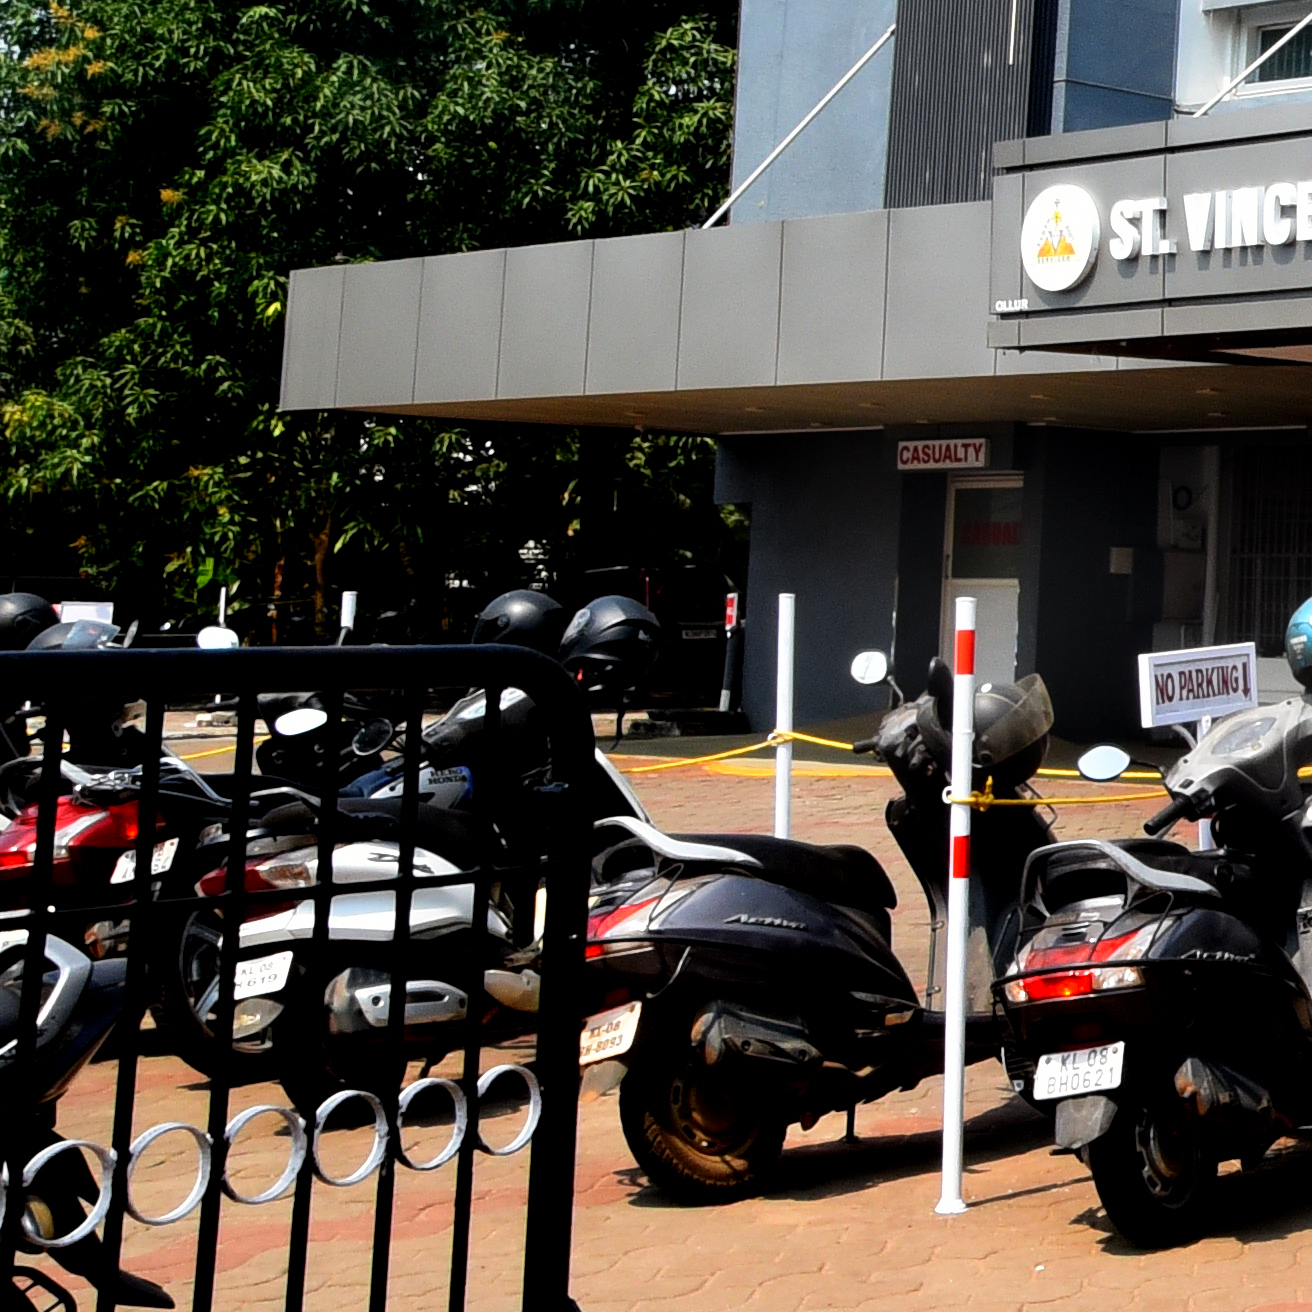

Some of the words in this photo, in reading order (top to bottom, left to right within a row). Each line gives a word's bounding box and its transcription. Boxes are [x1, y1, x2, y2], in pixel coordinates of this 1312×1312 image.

[1109, 197, 1177, 259] ST.
[995, 298, 1029, 312] OLLUR
[899, 442, 984, 466] CASUALTY
[1154, 673, 1175, 705] NO
[1178, 665, 1240, 700] PARKING
[427, 775, 468, 785] HONDA
[1060, 1054, 1079, 1073] KL
[1087, 1046, 1109, 1066] 08
[1046, 1066, 1115, 1095] BH0621
